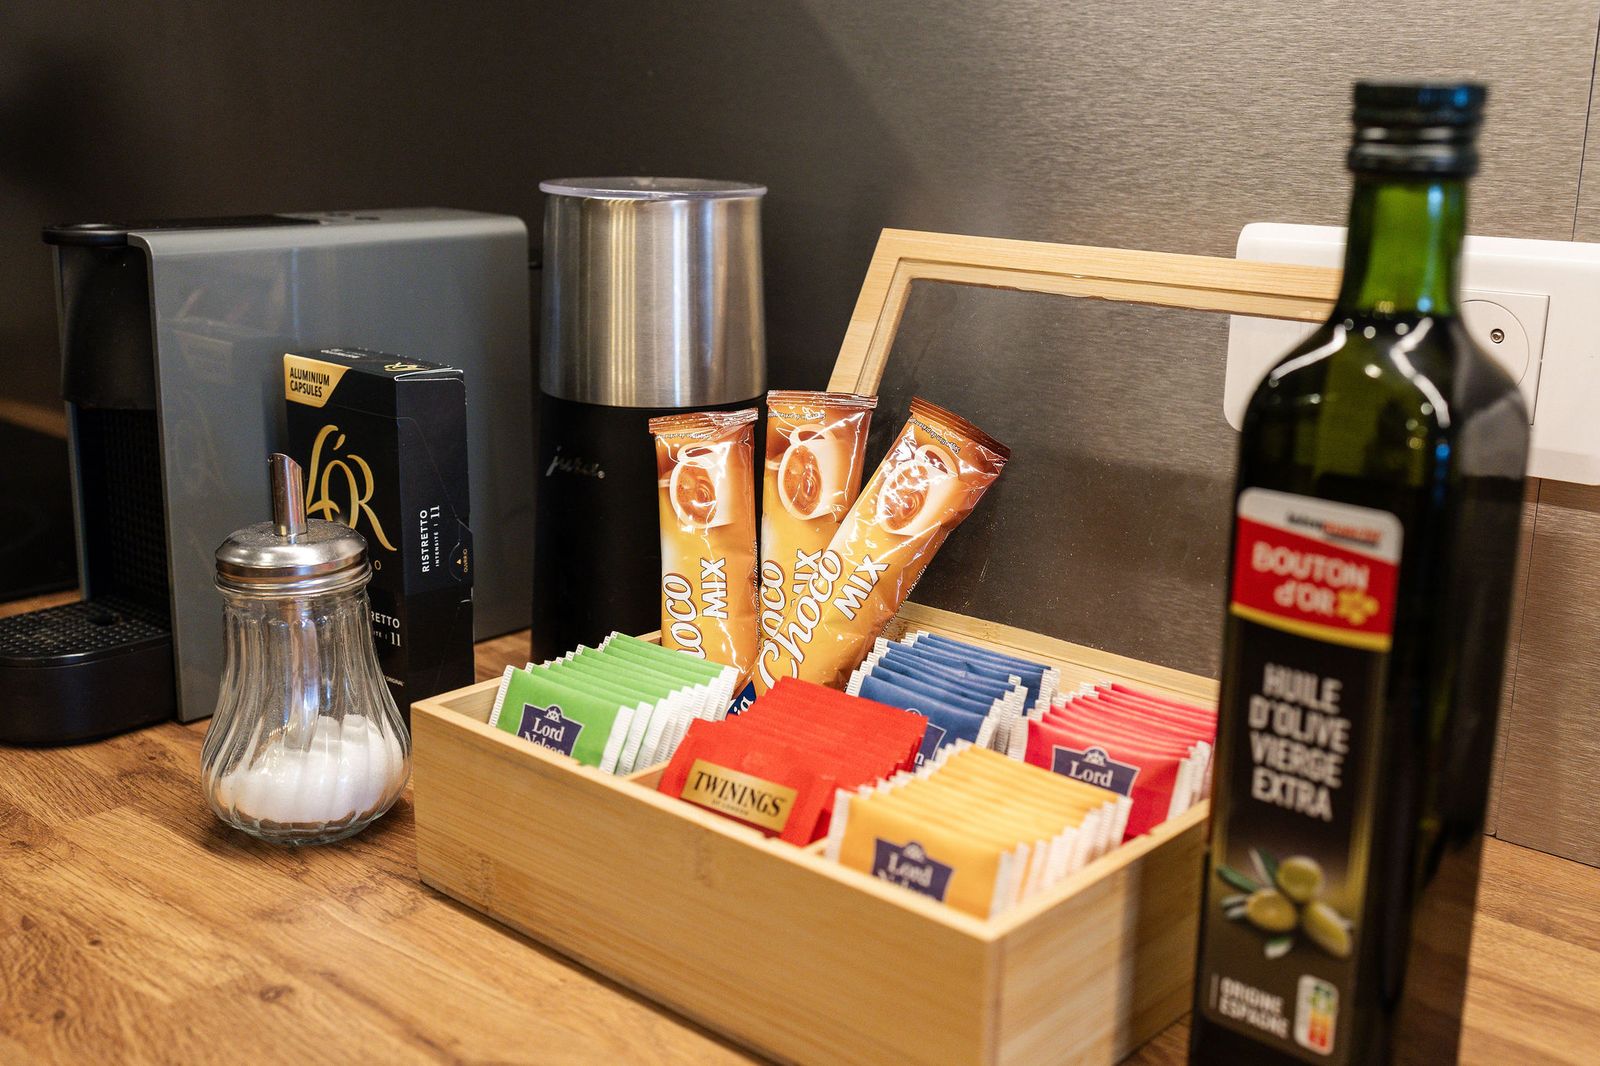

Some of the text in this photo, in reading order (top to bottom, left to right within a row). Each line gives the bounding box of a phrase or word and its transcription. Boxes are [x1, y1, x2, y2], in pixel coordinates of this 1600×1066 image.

[289, 367, 330, 386] ALUMINIUM
[289, 380, 322, 397] CAPSULES
[430, 504, 440, 519] 11
[419, 509, 430, 573] RISTRETTO
[1252, 541, 1369, 589] BOUTON
[700, 557, 728, 619] MIX
[761, 560, 788, 637] oco
[832, 554, 889, 620] MIX
[1274, 580, 1334, 617] d'OR
[371, 611, 401, 629] RETTO
[390, 632, 401, 647] 11
[663, 573, 706, 659] oco
[758, 550, 842, 689] Choco
[1262, 661, 1343, 714] HUILE
[532, 717, 565, 743] Lord
[1248, 693, 1350, 755] D'OLIVE
[1068, 760, 1114, 788] Lord
[1250, 730, 1344, 788] VIERGE
[693, 771, 784, 818] TWININGS
[1251, 766, 1333, 822] EXTRA
[887, 851, 934, 888] Lord
